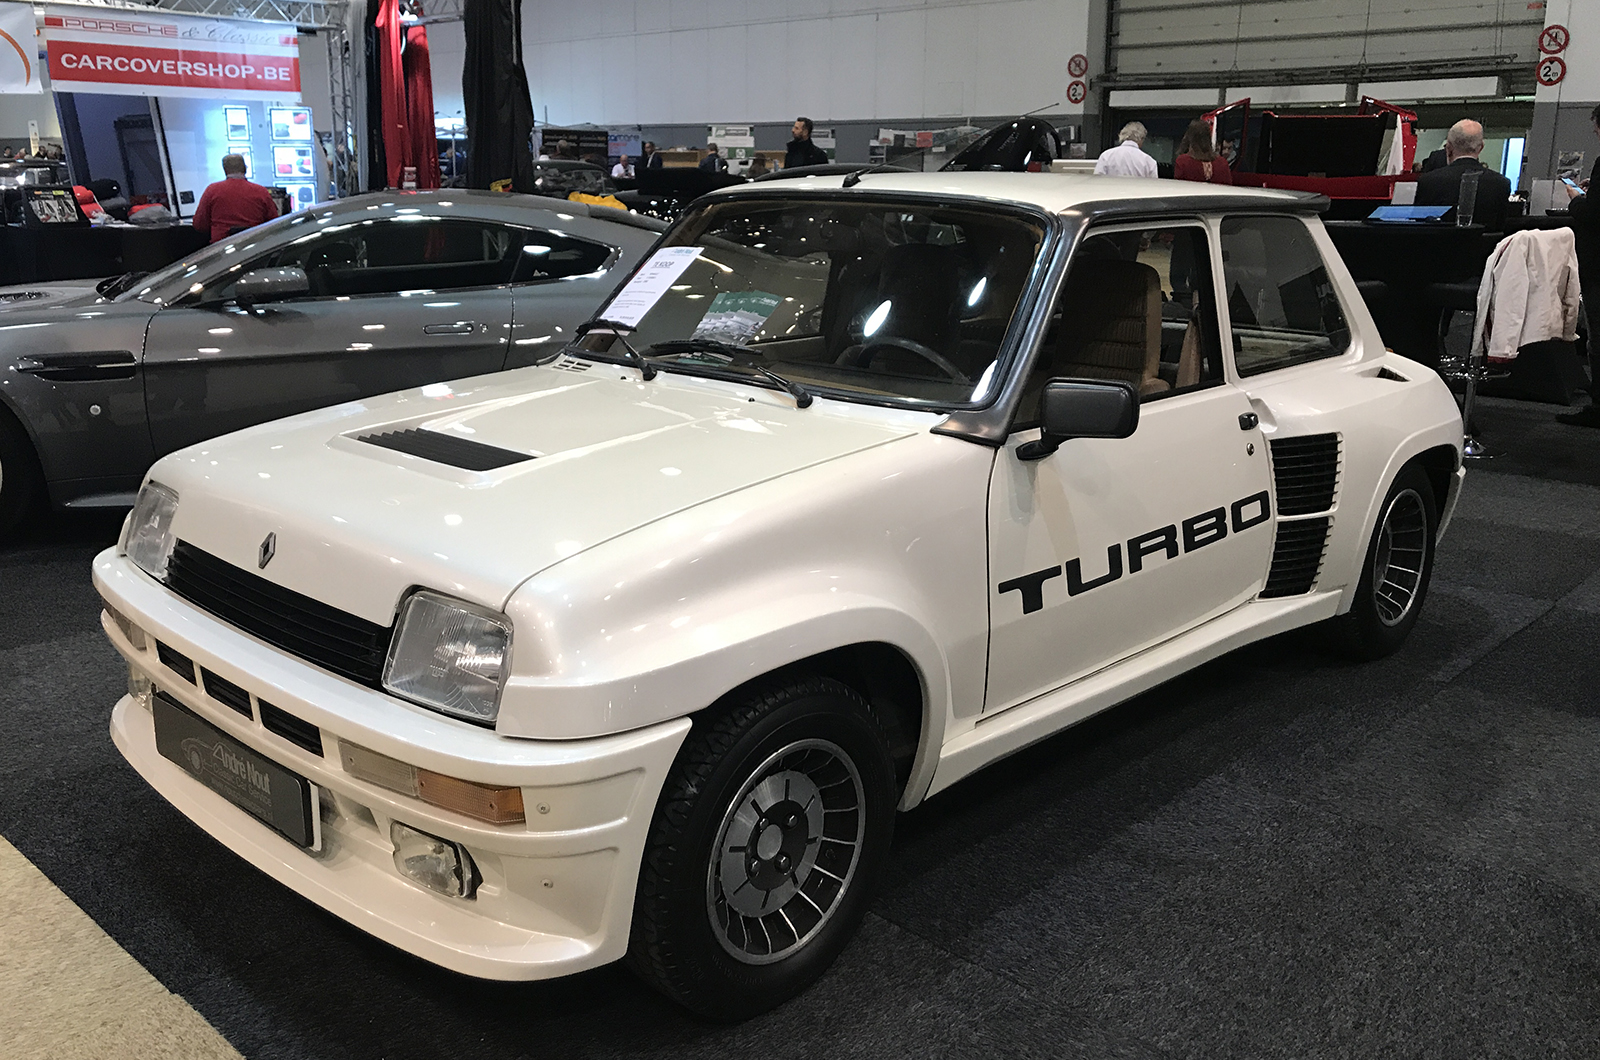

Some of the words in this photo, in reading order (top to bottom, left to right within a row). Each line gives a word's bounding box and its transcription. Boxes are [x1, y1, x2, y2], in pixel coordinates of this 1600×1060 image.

[65, 19, 178, 36] PORSCHE
[60, 53, 291, 81] CARCOVERSHOP.BE
[998, 490, 1271, 615] TURBO
[213, 744, 247, 780] André
[246, 760, 271, 795] Nout
